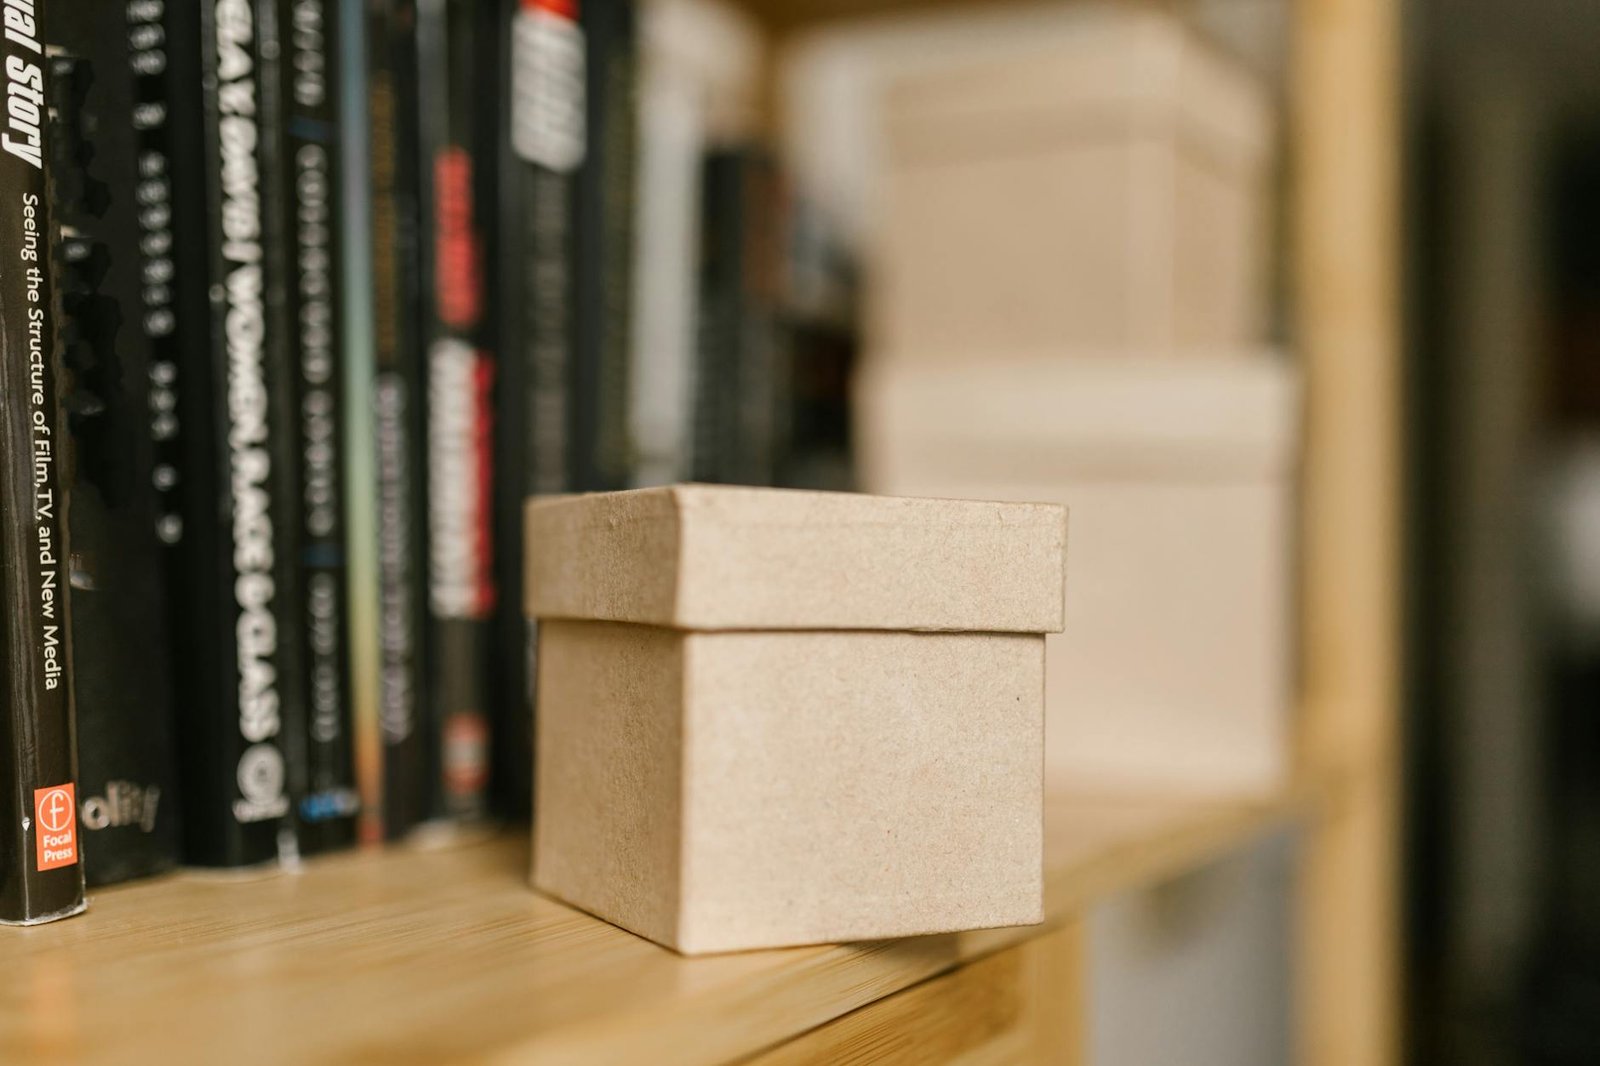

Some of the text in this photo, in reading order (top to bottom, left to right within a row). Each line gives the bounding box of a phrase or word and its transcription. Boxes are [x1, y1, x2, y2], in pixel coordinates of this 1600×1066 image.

[2, 54, 43, 170] Story
[20, 192, 40, 262] Seeing
[26, 266, 44, 303] the
[27, 307, 45, 405] Structure
[31, 410, 51, 436] of
[38, 526, 57, 565] and
[40, 570, 58, 619] New
[43, 625, 62, 690] Media
[43, 830, 72, 848] Focal
[43, 847, 73, 863] Press
